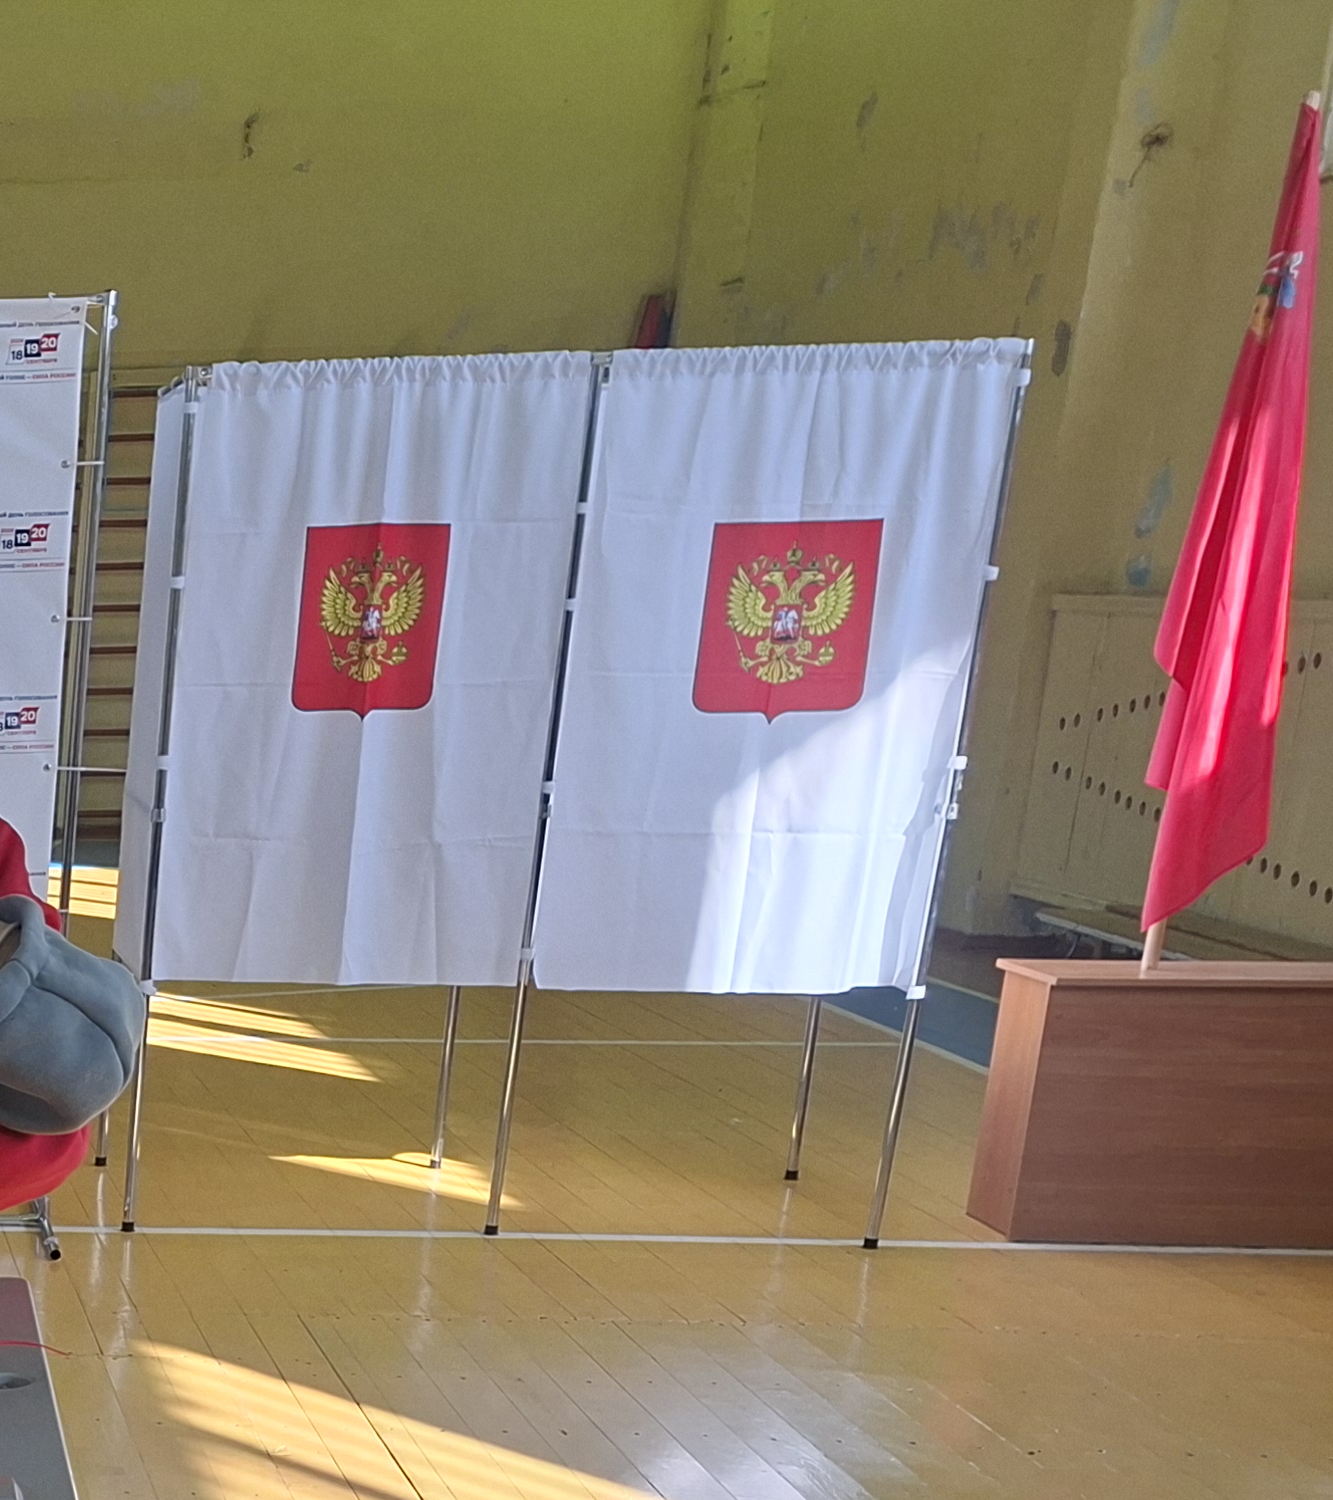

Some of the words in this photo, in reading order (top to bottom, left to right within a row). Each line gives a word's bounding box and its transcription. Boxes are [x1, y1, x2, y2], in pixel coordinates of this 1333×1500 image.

[12, 351, 22, 361] 18
[26, 344, 38, 354] 19
[41, 338, 56, 348] 20
[2, 541, 12, 550] 18
[16, 534, 28, 544] 19
[31, 528, 46, 538] 20
[7, 716, 19, 726] 19
[22, 711, 35, 721] 20
